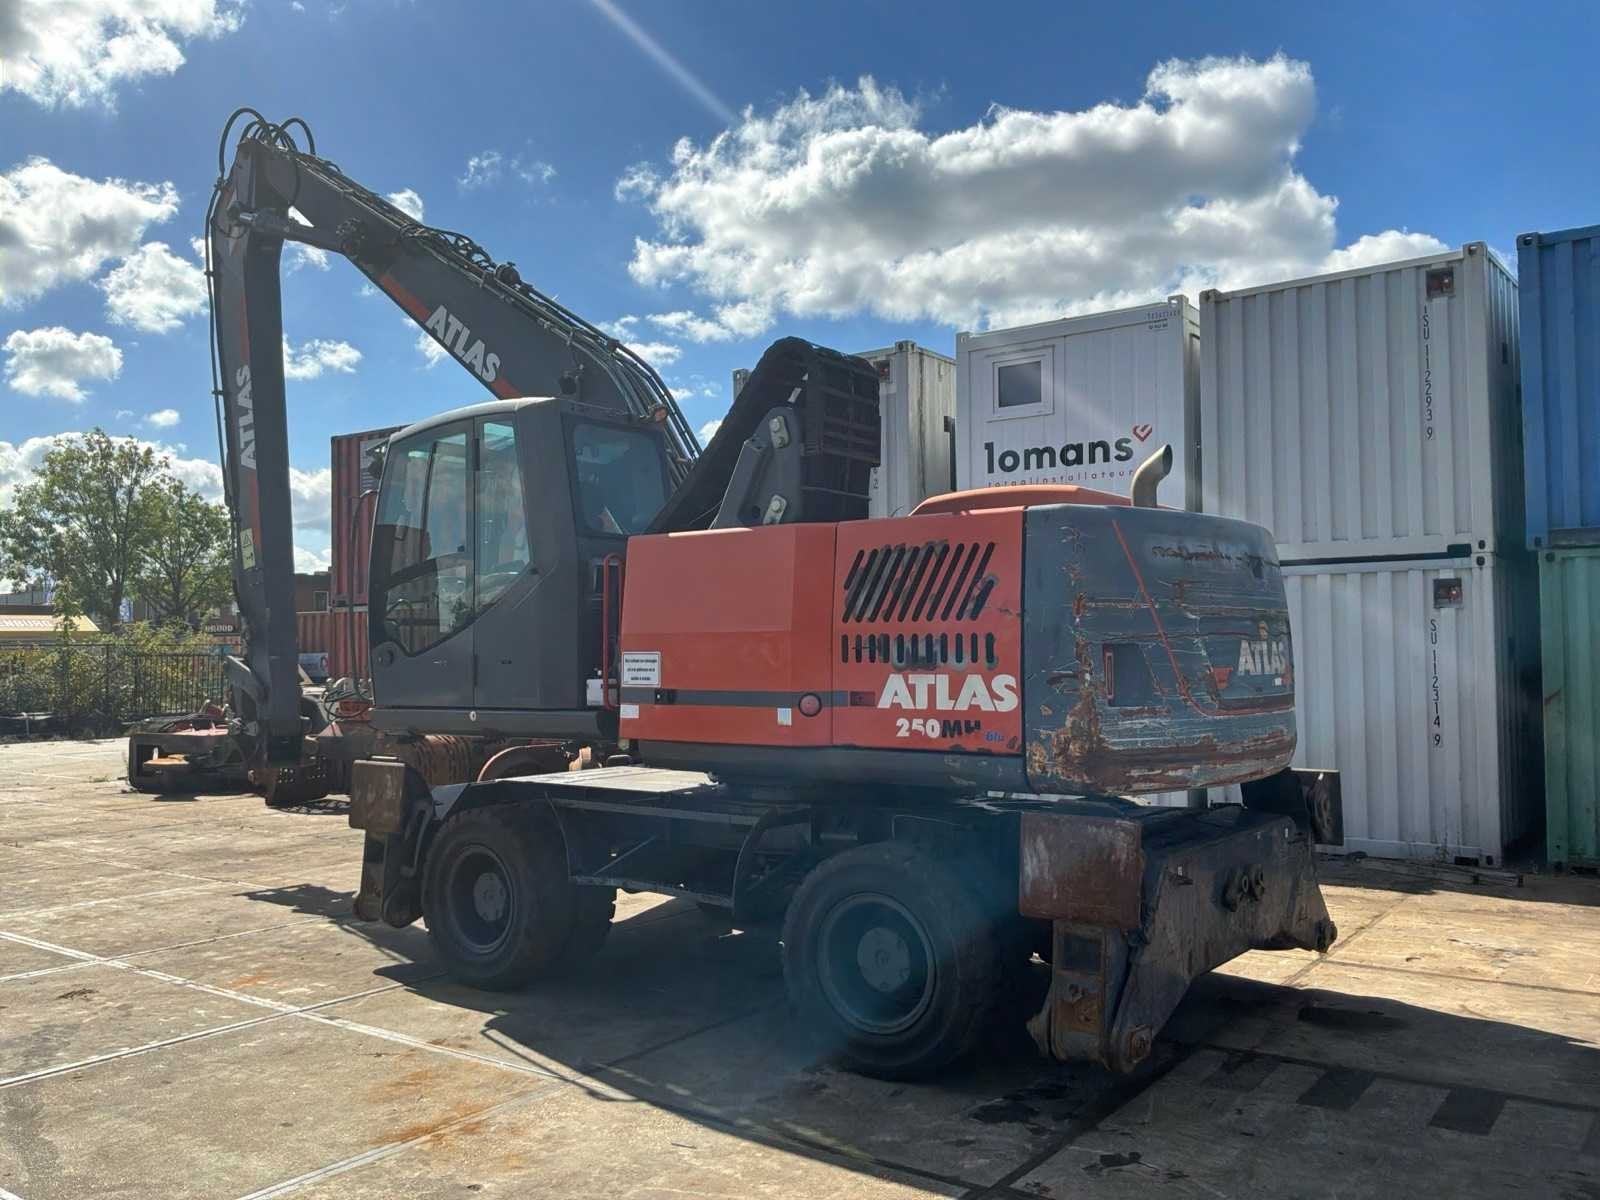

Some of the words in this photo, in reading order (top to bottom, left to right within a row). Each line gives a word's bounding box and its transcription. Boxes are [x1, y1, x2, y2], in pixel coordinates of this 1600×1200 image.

[424, 304, 501, 382] ATLAS
[236, 365, 257, 471] ATLAS
[984, 437, 1134, 474] lomans
[1238, 640, 1287, 676] ATLAS
[877, 674, 1019, 713] ATLAS
